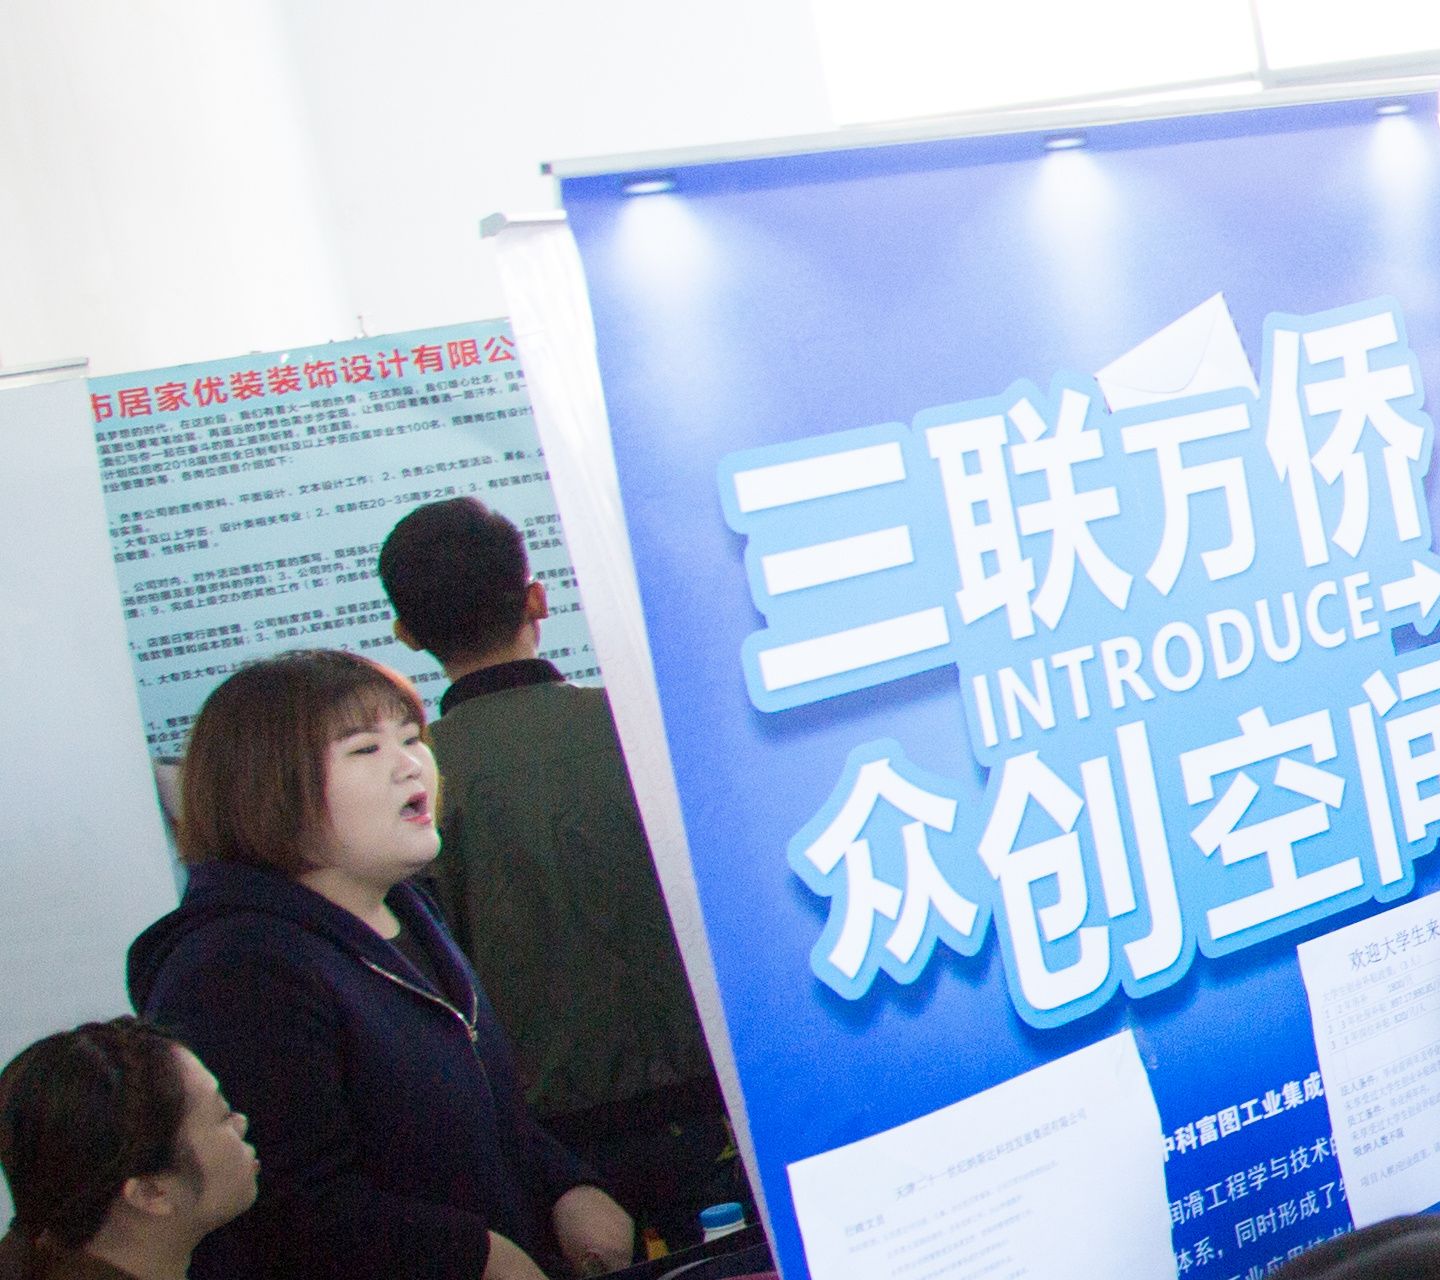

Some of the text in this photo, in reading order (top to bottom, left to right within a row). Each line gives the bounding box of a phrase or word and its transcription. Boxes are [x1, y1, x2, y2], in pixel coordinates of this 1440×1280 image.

[732, 310, 1425, 695] 三联万侨
[972, 570, 1382, 750] INTRODUCE
